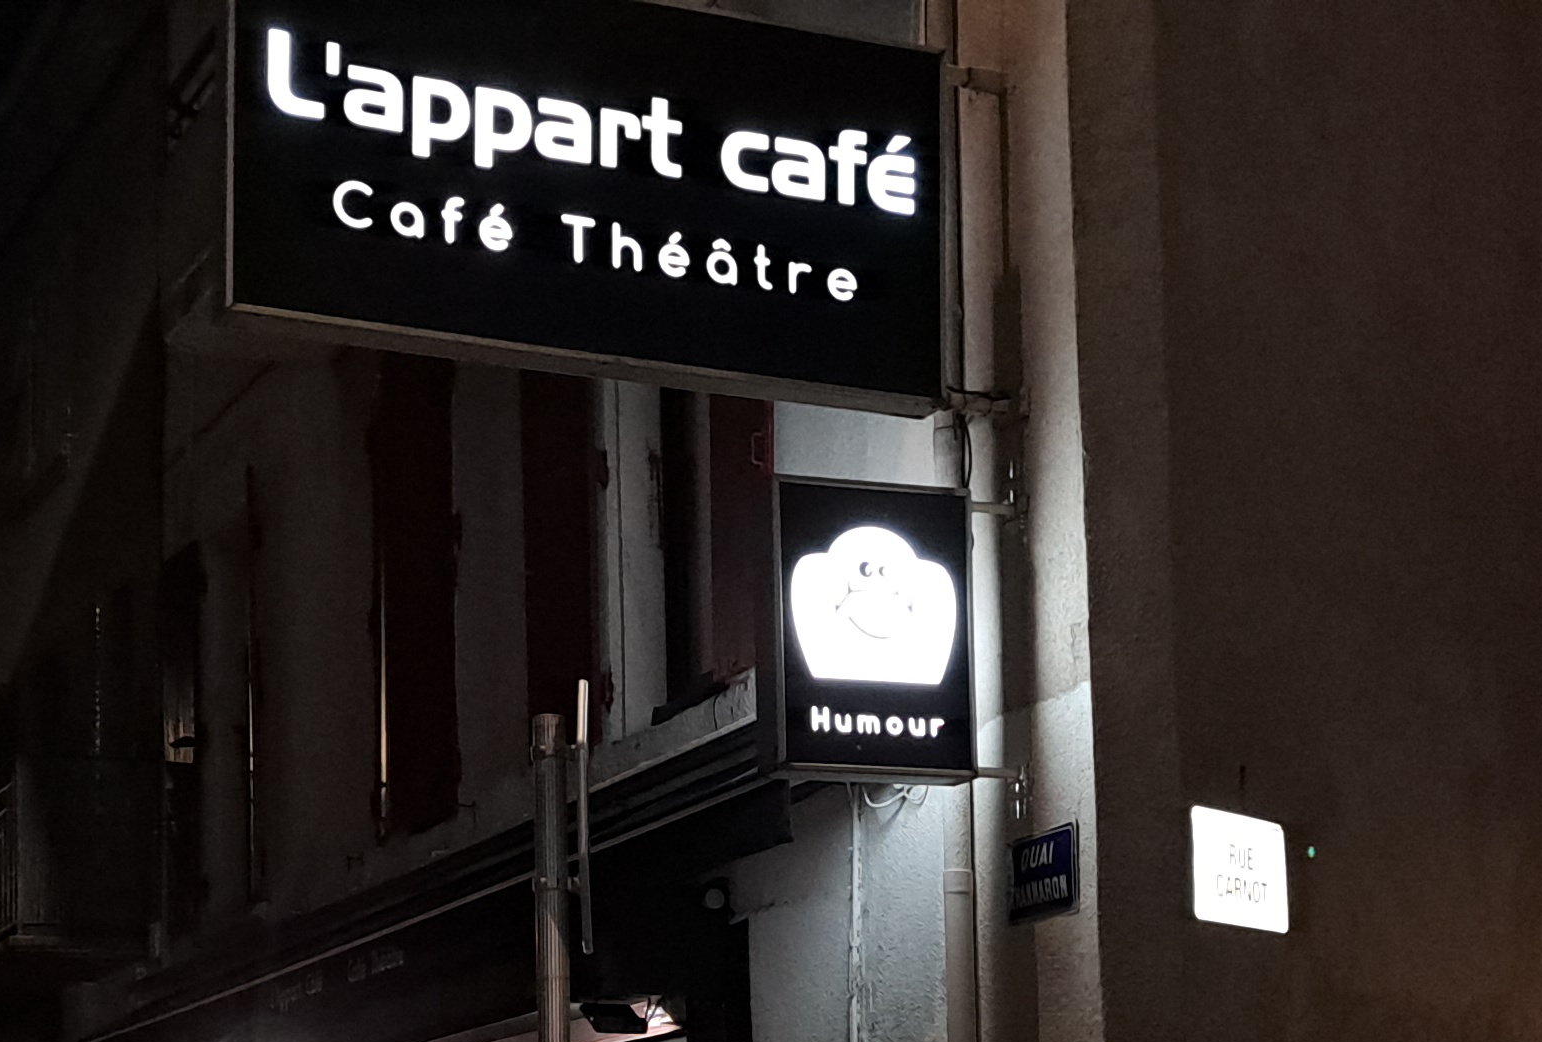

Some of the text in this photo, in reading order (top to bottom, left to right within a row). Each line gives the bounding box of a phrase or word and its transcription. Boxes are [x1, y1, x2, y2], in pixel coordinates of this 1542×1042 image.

[267, 27, 916, 216] L'appart café
[332, 180, 858, 302] Café Théâtre
[810, 705, 945, 738] Humour
[1020, 841, 1054, 872] QUAI
[1228, 843, 1254, 871] RUE
[1216, 874, 1268, 904] CARNOT
